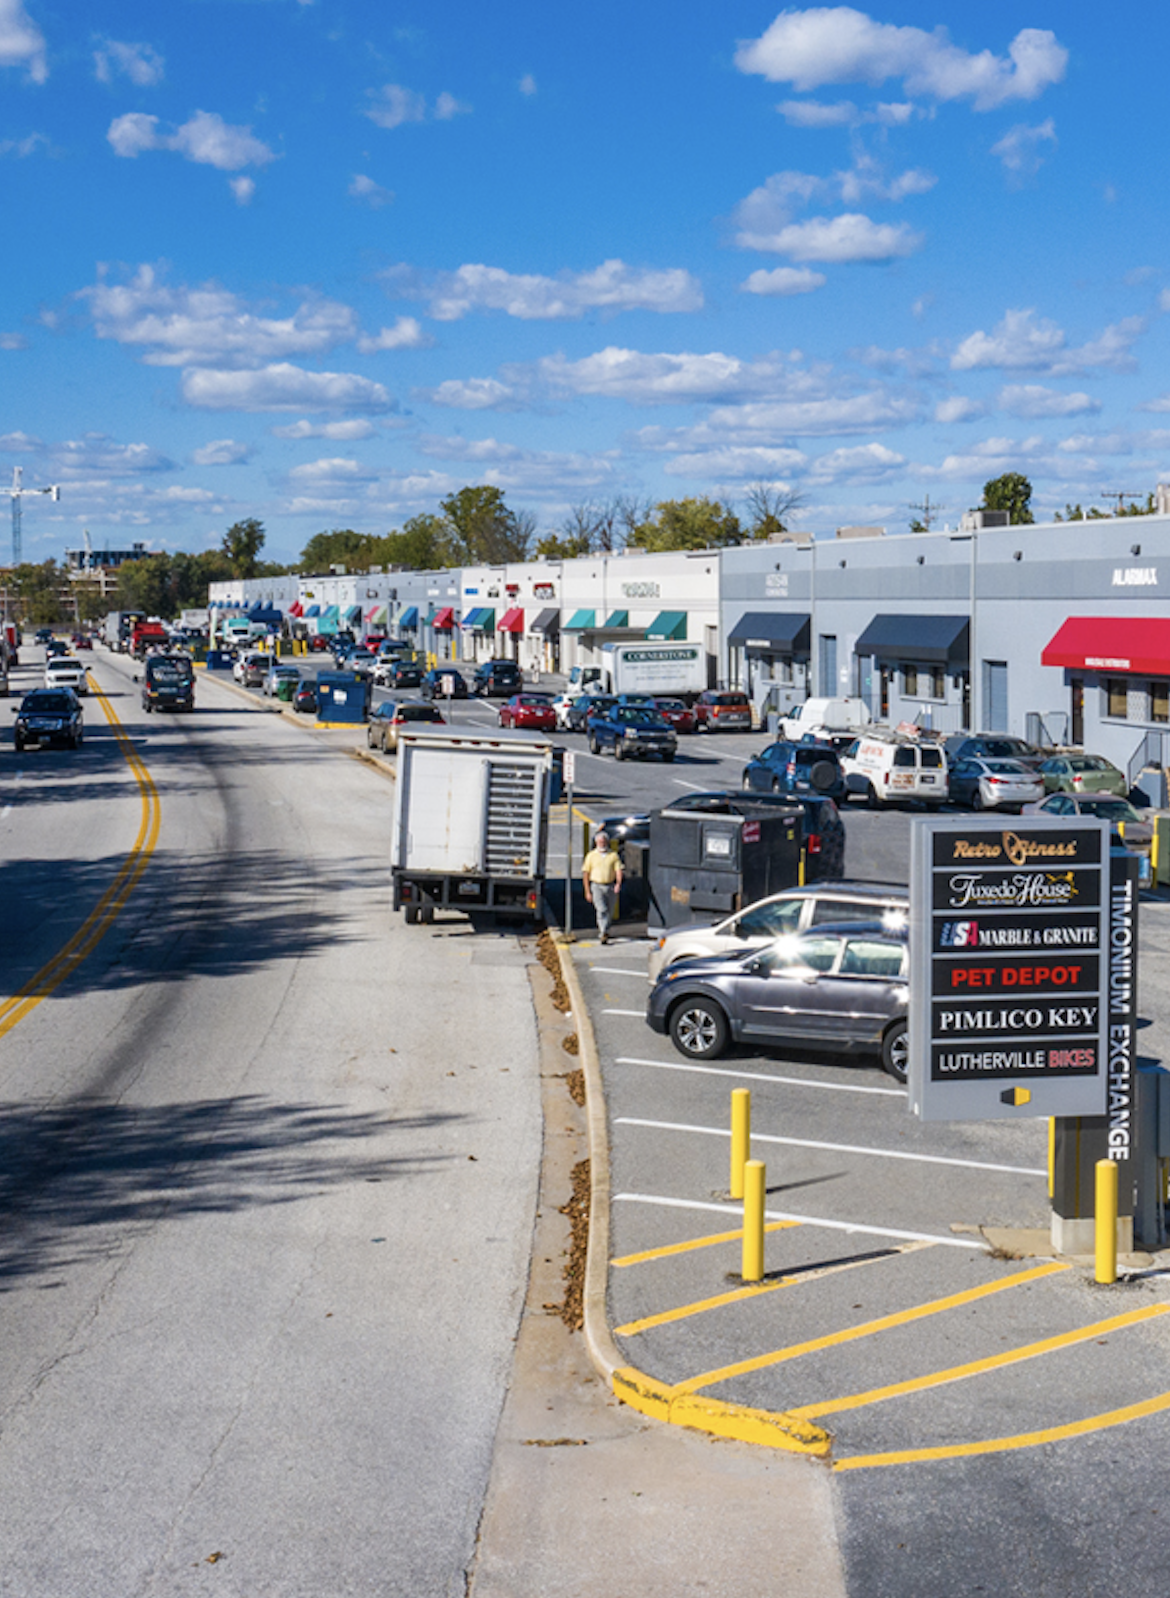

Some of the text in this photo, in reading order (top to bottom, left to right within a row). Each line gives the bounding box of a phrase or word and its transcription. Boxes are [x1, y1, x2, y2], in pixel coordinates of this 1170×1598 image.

[627, 650, 693, 661] CORNERSTONE
[953, 839, 1002, 858] Retro
[950, 874, 1071, 907] Tuxedo House
[940, 921, 1098, 946] USA MARBLE & GRANITE
[951, 966, 1081, 987] PET DEPOT
[939, 1007, 1097, 1030] PIMLICO KEY
[1108, 879, 1132, 1160] TIMONIUM EXCHANGE
[939, 1048, 1095, 1071] LUTHERVILLE BIKES
